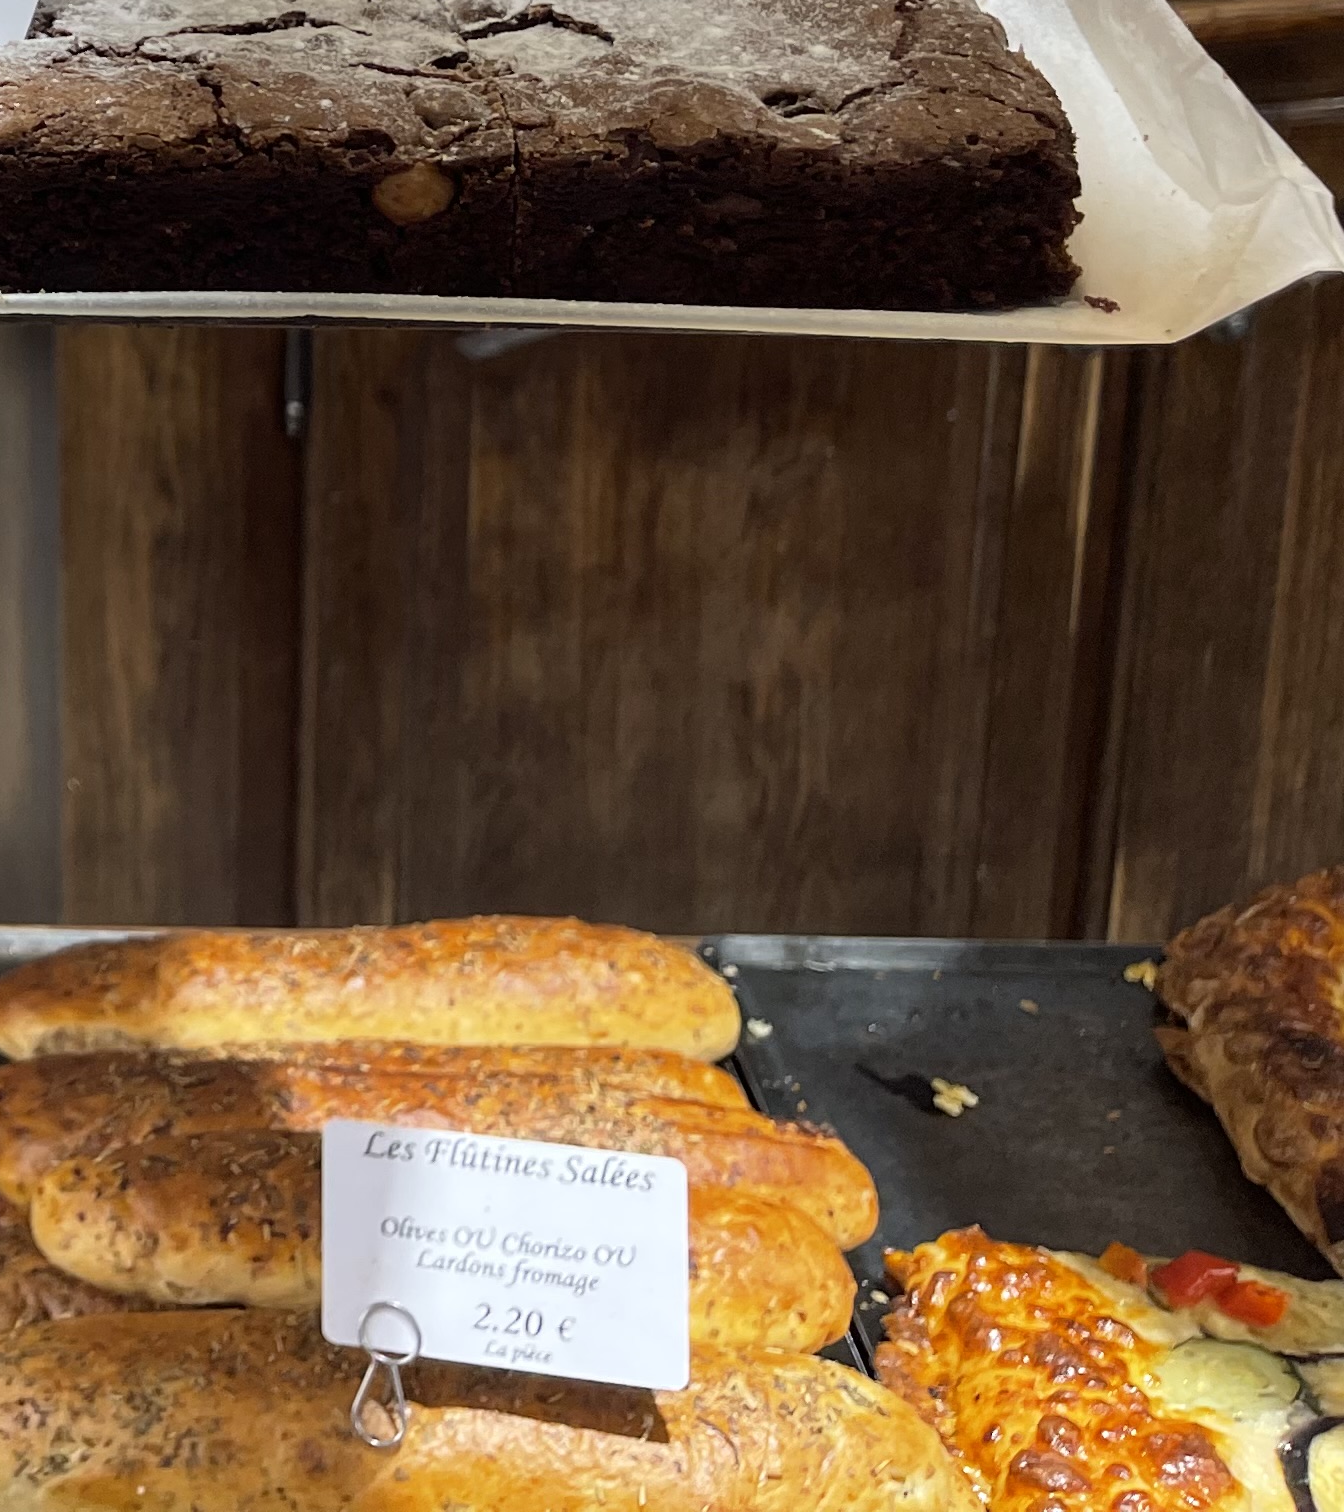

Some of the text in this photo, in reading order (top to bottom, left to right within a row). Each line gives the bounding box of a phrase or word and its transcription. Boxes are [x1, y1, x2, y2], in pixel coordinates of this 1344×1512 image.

[363, 1131, 656, 1193] Les Flûtines Salées
[380, 1216, 637, 1268] Olives OU Chorizo OU
[417, 1251, 600, 1297] Lardons fromage
[473, 1303, 577, 1342] 2.20 €
